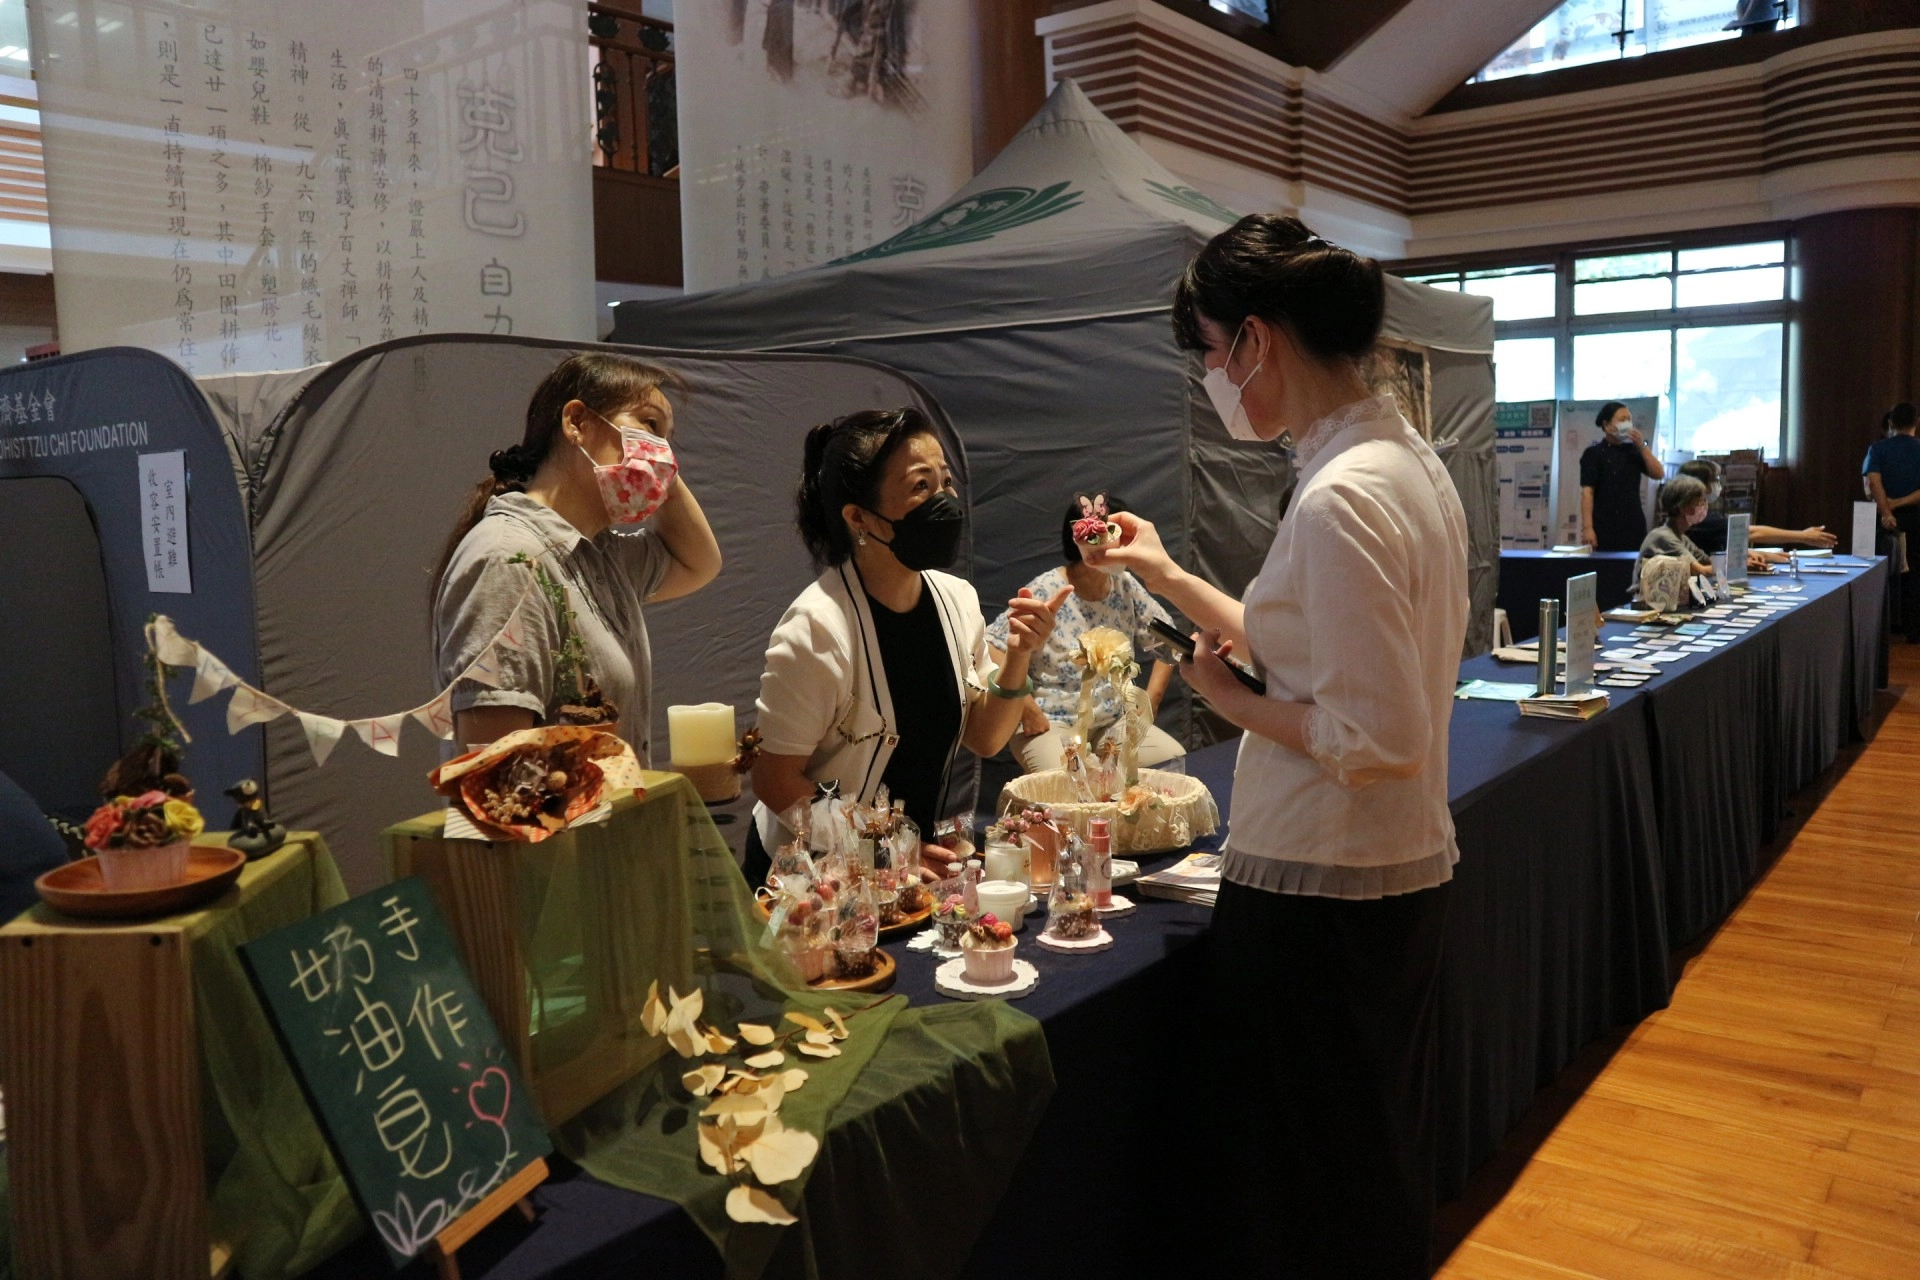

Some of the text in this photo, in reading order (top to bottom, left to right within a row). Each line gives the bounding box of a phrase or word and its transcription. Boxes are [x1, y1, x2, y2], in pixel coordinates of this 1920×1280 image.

[402, 67, 430, 335] 四十多年來，證嚴上人及精
[480, 257, 513, 334] 自力
[27, 435, 48, 458] TZU
[49, 433, 69, 457] CHI
[70, 420, 149, 454] FOUNDATION
[288, 923, 453, 1181] 奶油皂
[378, 896, 469, 1061] 手作
